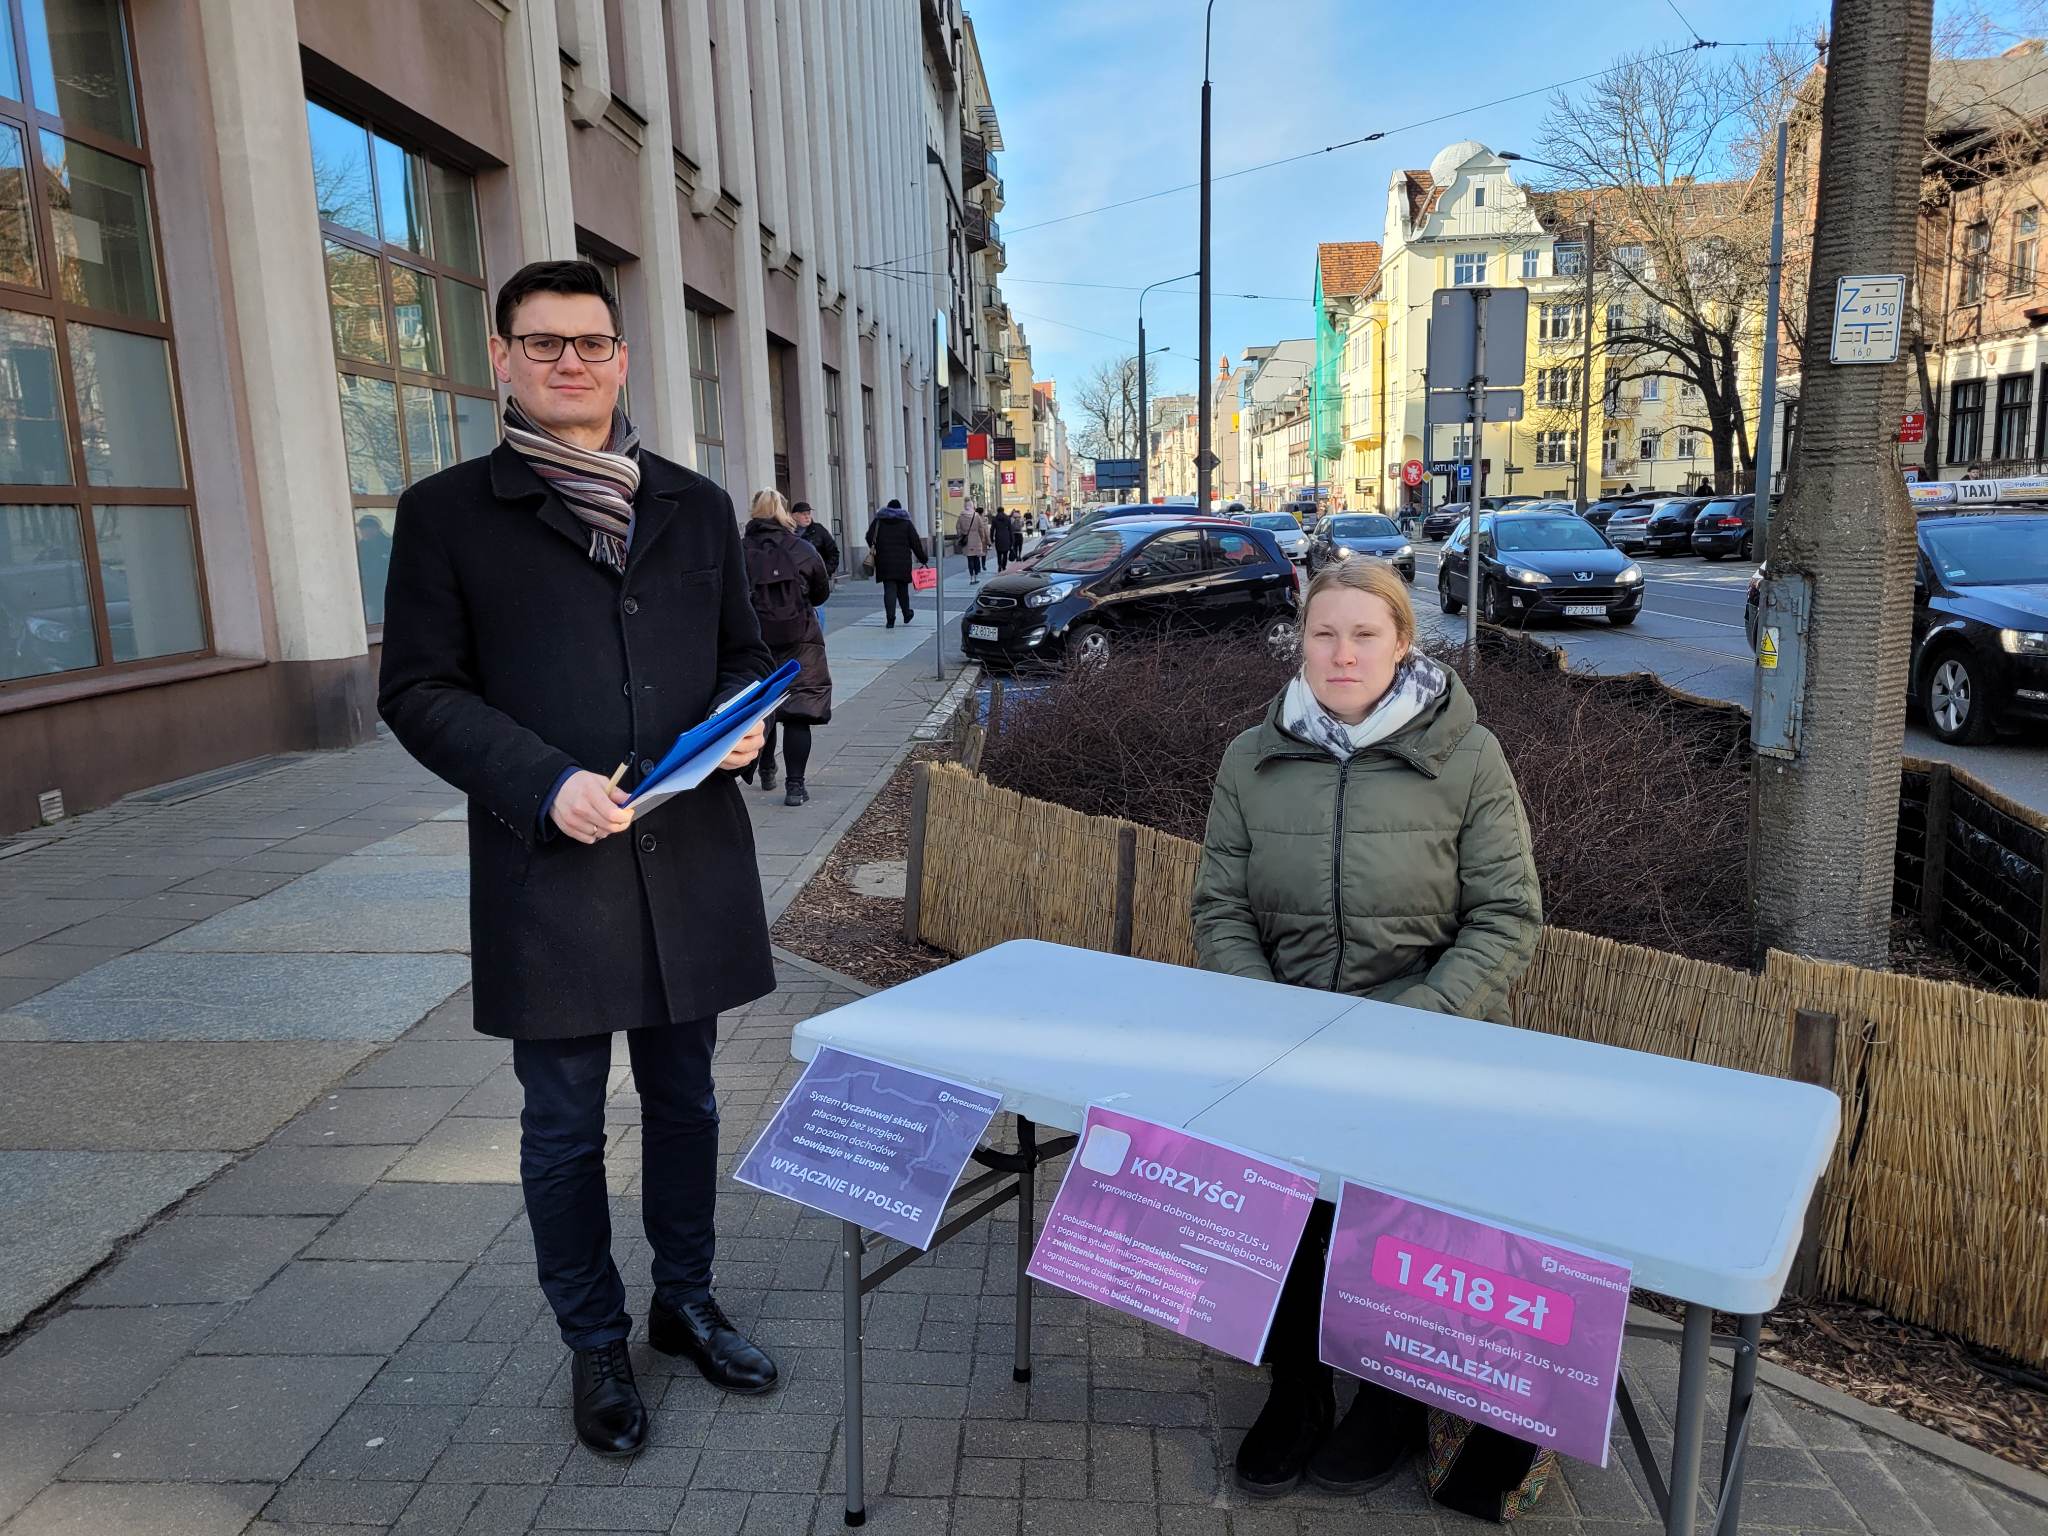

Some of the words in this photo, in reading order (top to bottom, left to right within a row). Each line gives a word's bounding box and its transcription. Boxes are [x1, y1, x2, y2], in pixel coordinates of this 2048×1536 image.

[1841, 288, 1860, 312] Z
[1875, 302, 1896, 316] 150
[1960, 484, 1992, 498] TAXI
[810, 1090, 841, 1107] System
[841, 1100, 894, 1124] ryczałtowej
[892, 1116, 928, 1134] składki
[812, 1108, 850, 1128] płaconej
[850, 1120, 866, 1132] bez
[866, 1125, 905, 1143] względu
[949, 1096, 994, 1115] Porozumienie
[792, 1135, 843, 1158] obowiązuje
[844, 1151, 854, 1160] w
[853, 1154, 890, 1174] Europie
[804, 1122, 816, 1132] na
[815, 1128, 848, 1142] poziom
[848, 1136, 897, 1158] dochodów
[770, 1156, 848, 1194] WYŁĄCZNIE
[848, 1183, 866, 1199] W
[864, 1190, 923, 1222] POLSCE
[1130, 1156, 1246, 1214] KORZYŚCI
[1257, 1175, 1314, 1202] Porozumienie
[1099, 1182, 1162, 1209] wprowadzenia
[1163, 1204, 1236, 1238] dobrowolnego
[1236, 1232, 1270, 1251] ZUS-u
[1056, 1226, 1088, 1242] poprawa
[1088, 1238, 1116, 1253] sytuacji
[1115, 1248, 1201, 1286] mikroprzedsiębiorstw
[1102, 1228, 1132, 1245] polskiej
[1132, 1240, 1208, 1275] przedsiębiorczości
[1179, 1224, 1196, 1237] dla
[1196, 1232, 1284, 1272] przedsiębiorców
[1042, 1263, 1065, 1278] wzrost
[1065, 1272, 1100, 1290] wpływów
[1100, 1286, 1110, 1295] do
[1110, 1290, 1143, 1310] budżetu
[1142, 1304, 1180, 1324] państwa
[1047, 1251, 1090, 1272] ograniczenie
[1090, 1267, 1134, 1290] działalności
[1134, 1284, 1151, 1297] firm
[1152, 1293, 1160, 1301] w
[1160, 1296, 1186, 1312] szarej
[1186, 1306, 1212, 1322] strefie
[1052, 1238, 1095, 1260] zwiększenie
[1095, 1254, 1162, 1286] konkurencyjności
[1162, 1282, 1196, 1300] polskich
[1198, 1295, 1216, 1310] firm
[1397, 1251, 1412, 1285] 1
[1422, 1263, 1494, 1312] 418
[1504, 1294, 1550, 1330] zł
[1558, 1264, 1628, 1293] Porozumienie
[1338, 1290, 1392, 1315] wysokość
[1393, 1308, 1476, 1346] comiesięcznej
[1478, 1338, 1522, 1360] składki
[1524, 1353, 1551, 1370] ZUS
[1553, 1364, 1565, 1375] w
[1568, 1368, 1599, 1386] 2023
[1384, 1330, 1532, 1396] NIEZALEŻNIE
[1360, 1356, 1382, 1371] OD
[1384, 1366, 1478, 1408] OSIĄGANEGO
[1480, 1402, 1556, 1437] DOCHODU
